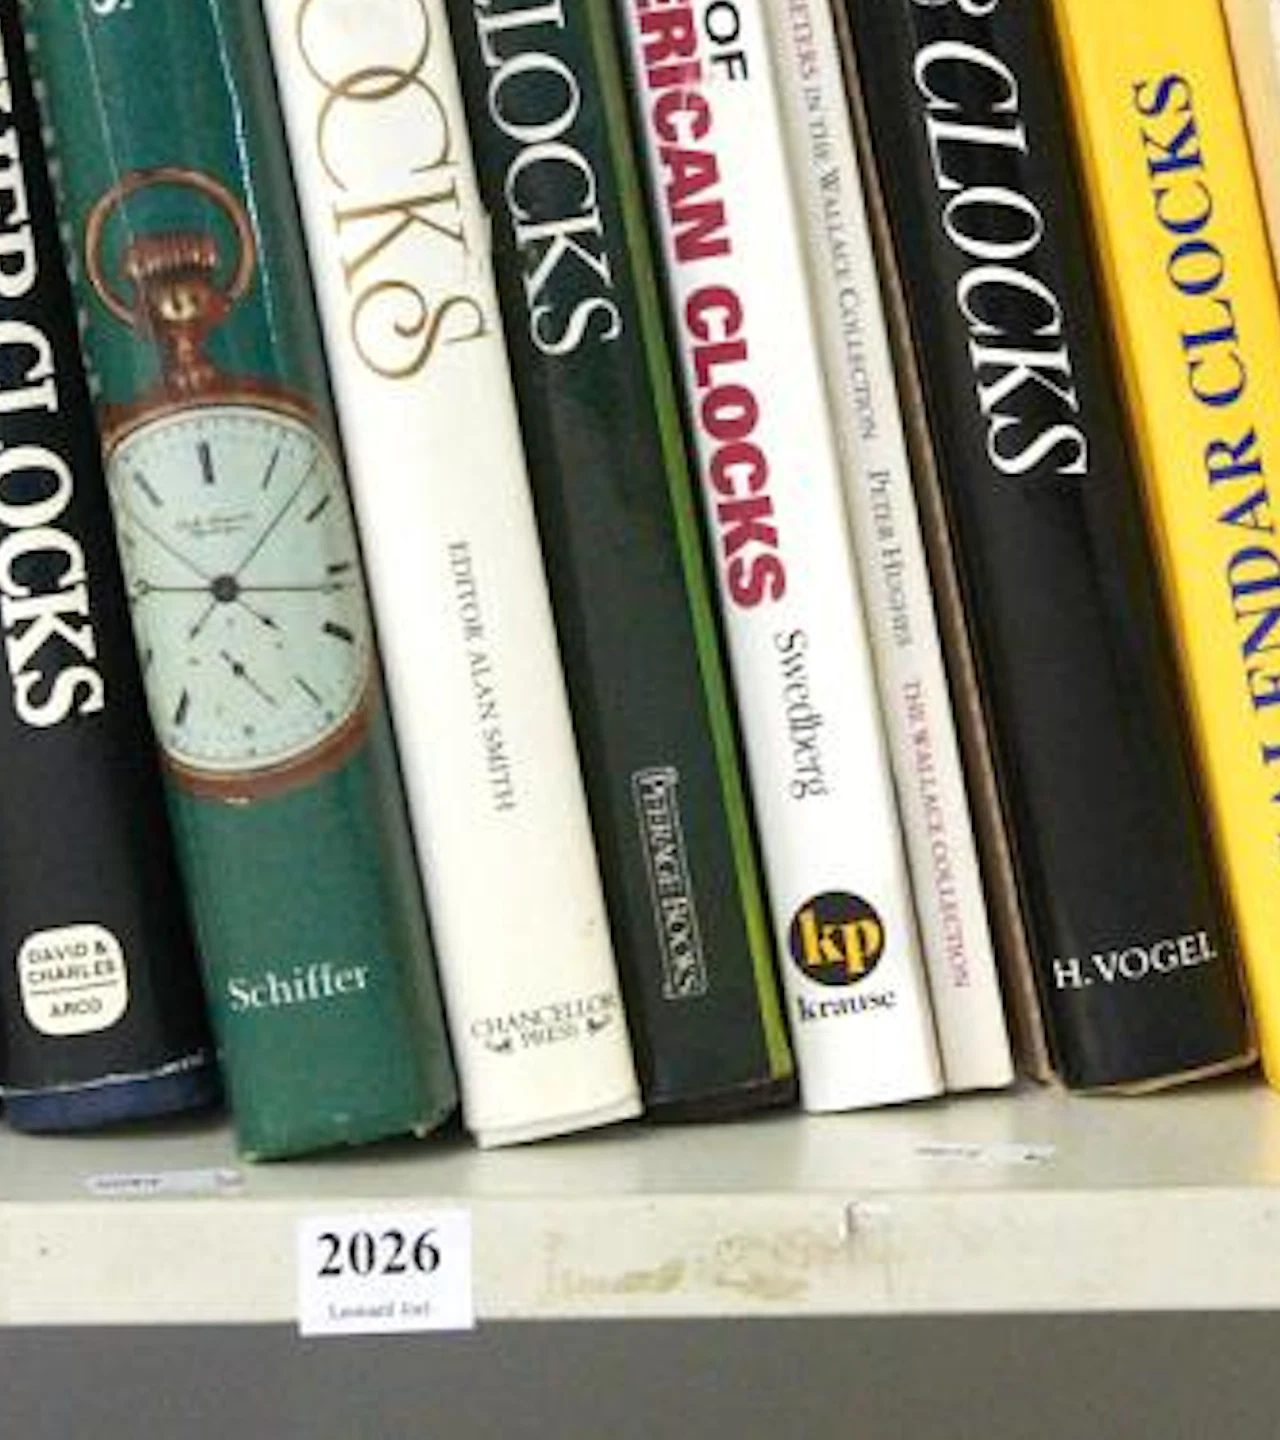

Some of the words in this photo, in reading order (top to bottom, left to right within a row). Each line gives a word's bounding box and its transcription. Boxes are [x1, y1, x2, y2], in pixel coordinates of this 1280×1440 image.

[913, 40, 1088, 477] CLOCKS
[1131, 71, 1247, 408] CLOCKS
[683, 283, 787, 611] CLOCKS
[452, 538, 486, 648] EDITOR
[468, 654, 500, 730] ALAN
[773, 628, 830, 801] Swedberg
[488, 730, 518, 815] SMITH
[907, 732, 949, 838] WALLACE
[798, 908, 885, 976] kp
[924, 838, 976, 990] COLLECTION
[226, 961, 370, 1013] Schiffer
[798, 988, 897, 1025] krause
[317, 1227, 441, 1277] 2026
